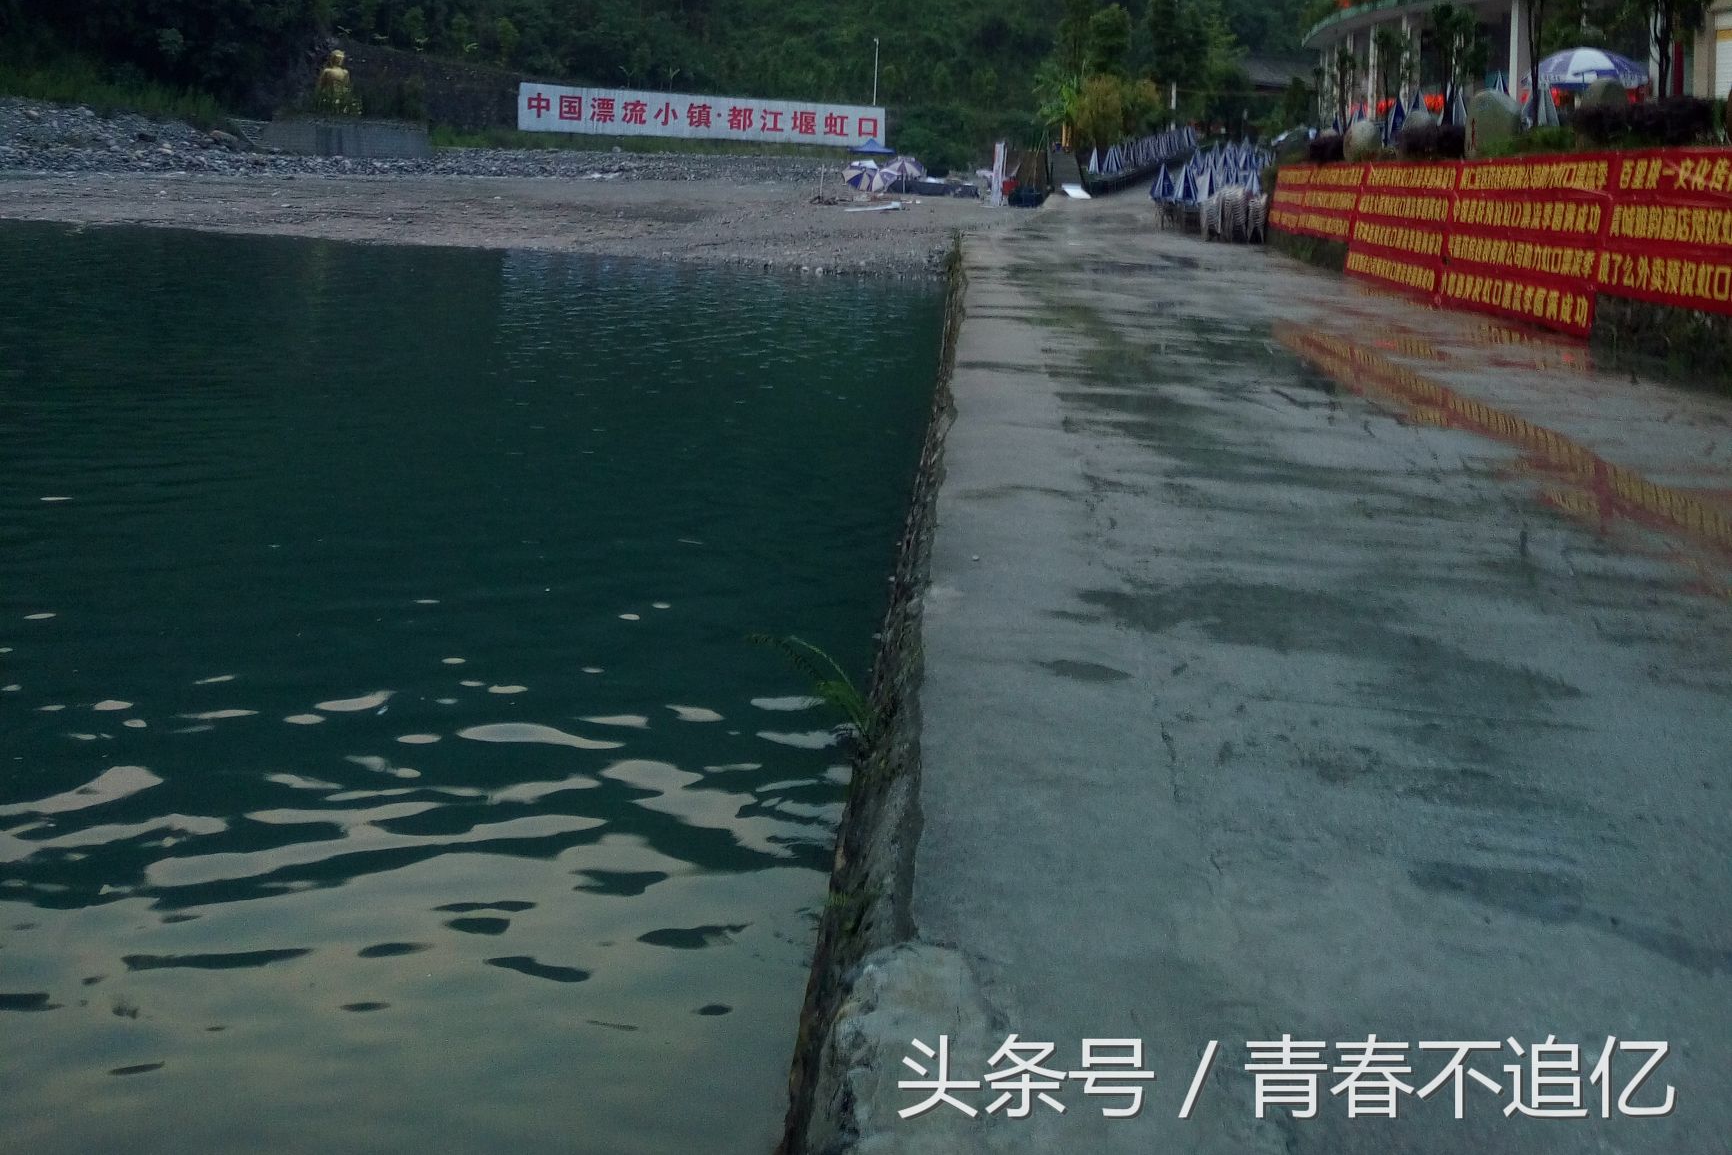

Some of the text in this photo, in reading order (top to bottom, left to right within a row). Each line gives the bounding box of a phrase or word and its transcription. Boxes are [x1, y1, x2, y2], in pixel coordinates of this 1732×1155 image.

[526, 91, 879, 138] 中国漂流小镇·都江堰虹口
[1619, 156, 1732, 192] 百里挑一文化传
